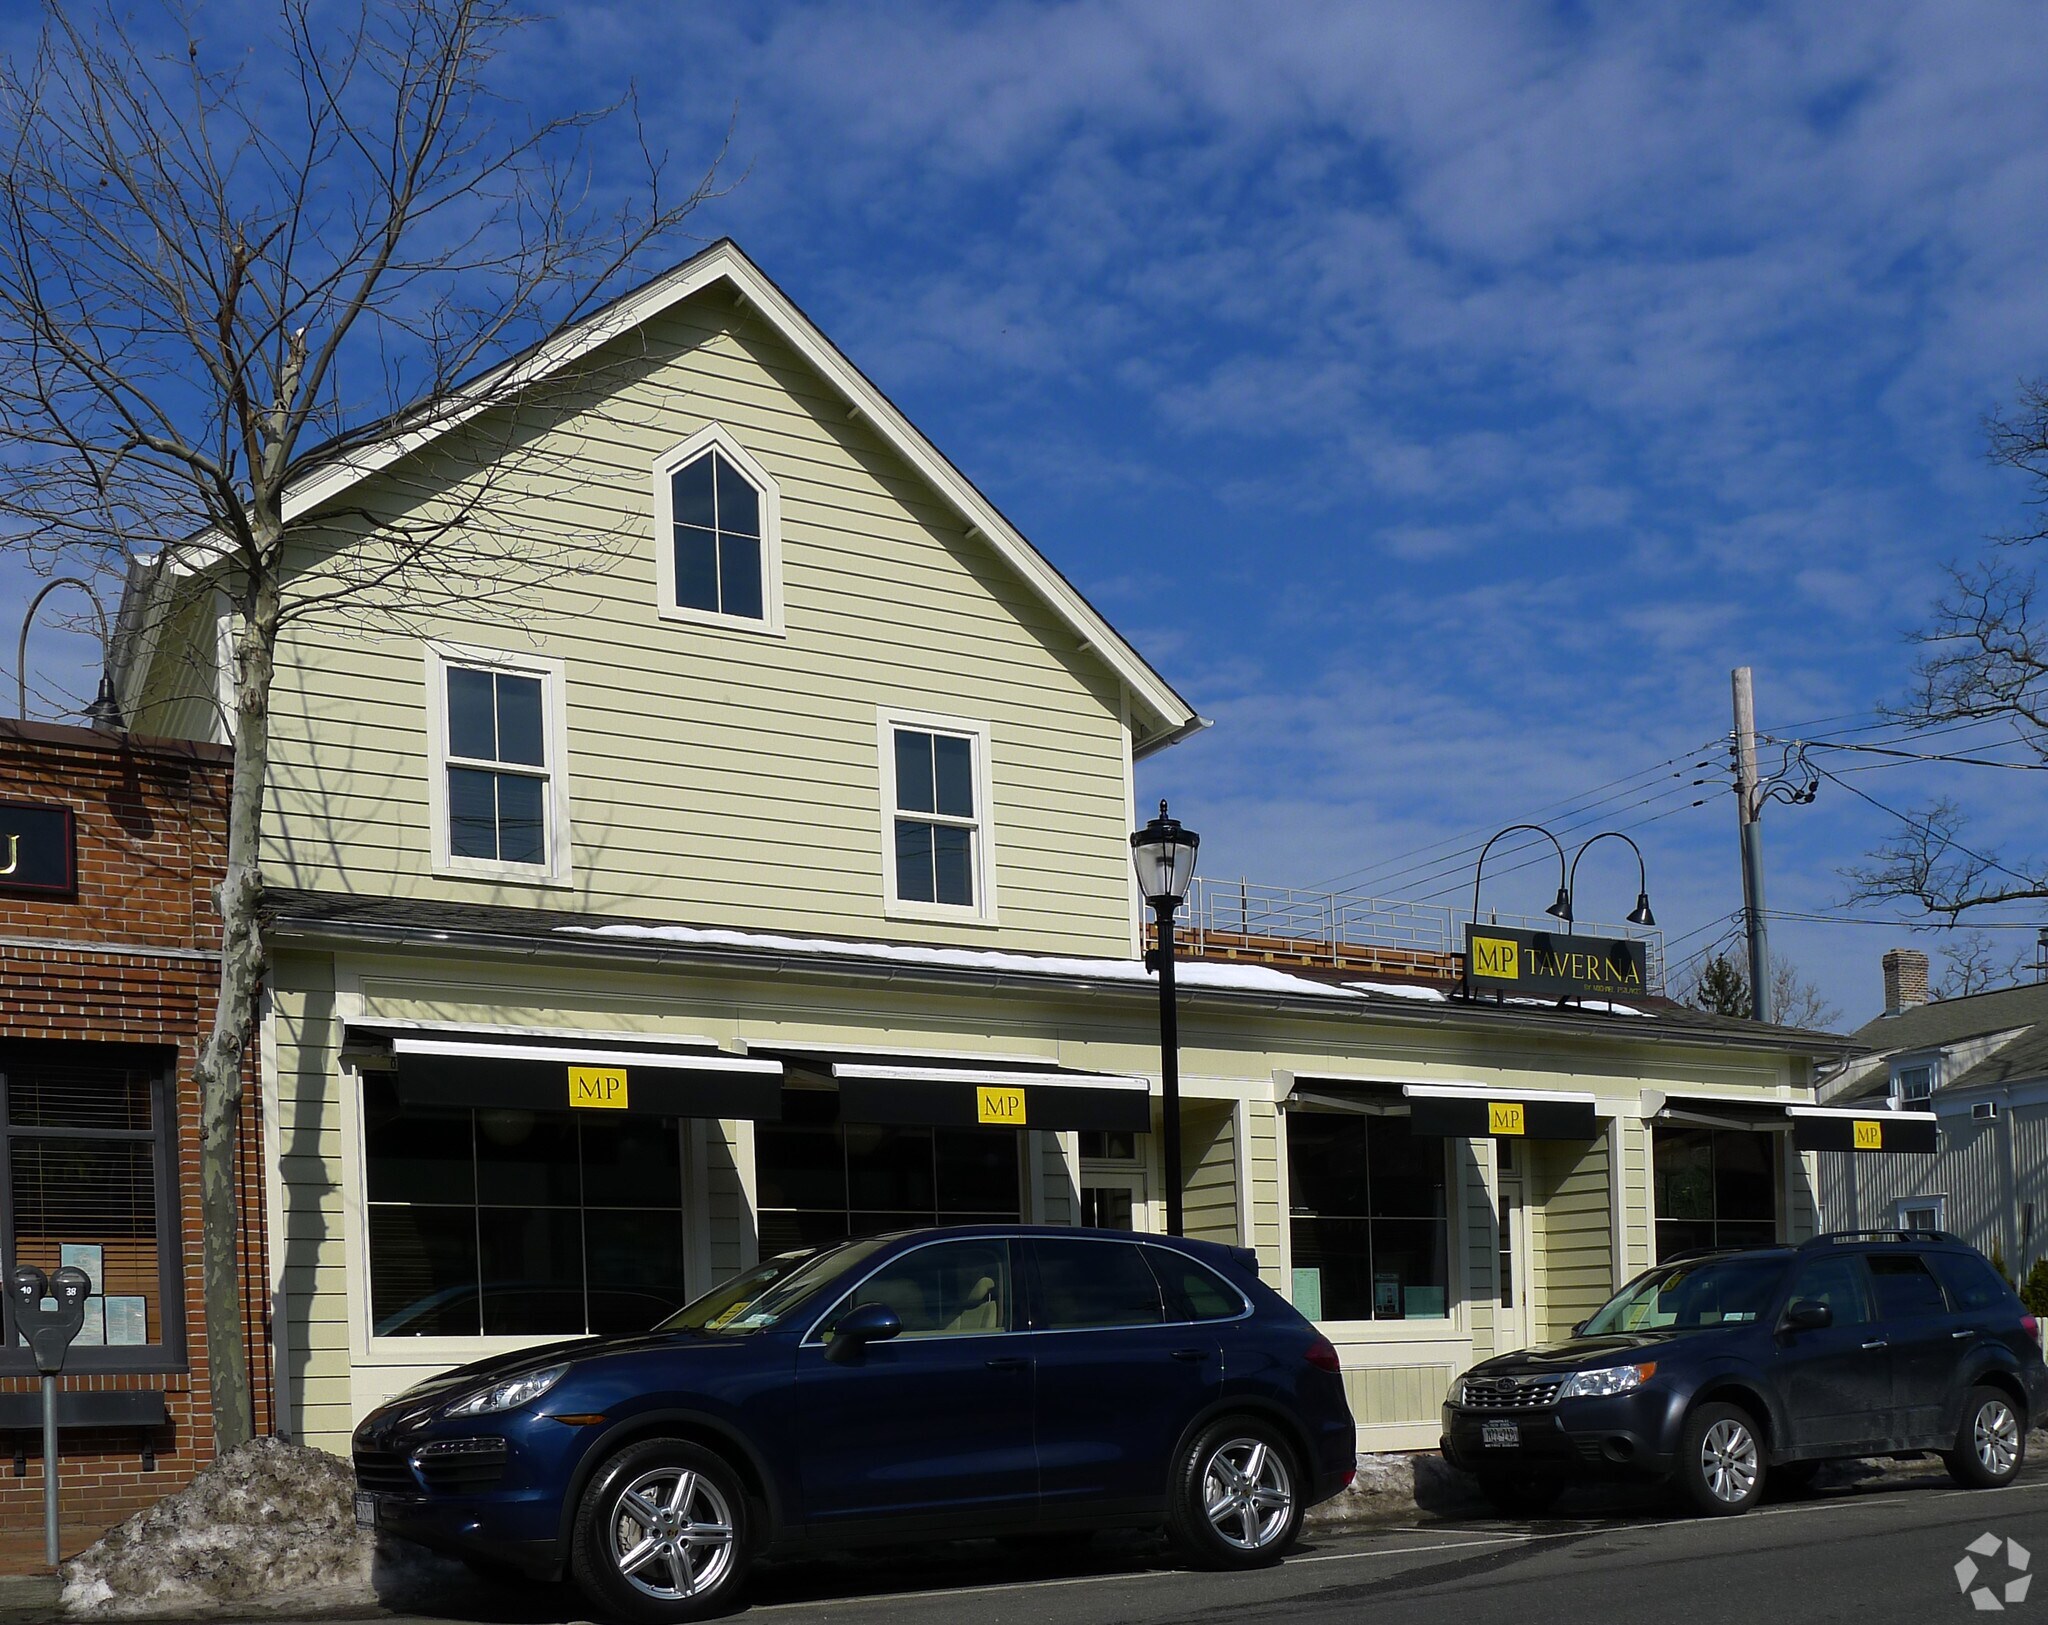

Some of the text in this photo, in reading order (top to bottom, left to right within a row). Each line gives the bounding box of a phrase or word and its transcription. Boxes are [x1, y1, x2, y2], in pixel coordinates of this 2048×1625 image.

[1477, 942, 1514, 973] MP
[1524, 948, 1640, 984] TAVERNA
[577, 1076, 620, 1100] MP
[985, 1095, 1019, 1117] MP
[1494, 1110, 1520, 1129] MP
[1858, 1127, 1878, 1143] MP
[20, 1286, 32, 1295] 40
[65, 1287, 77, 1296] 38
